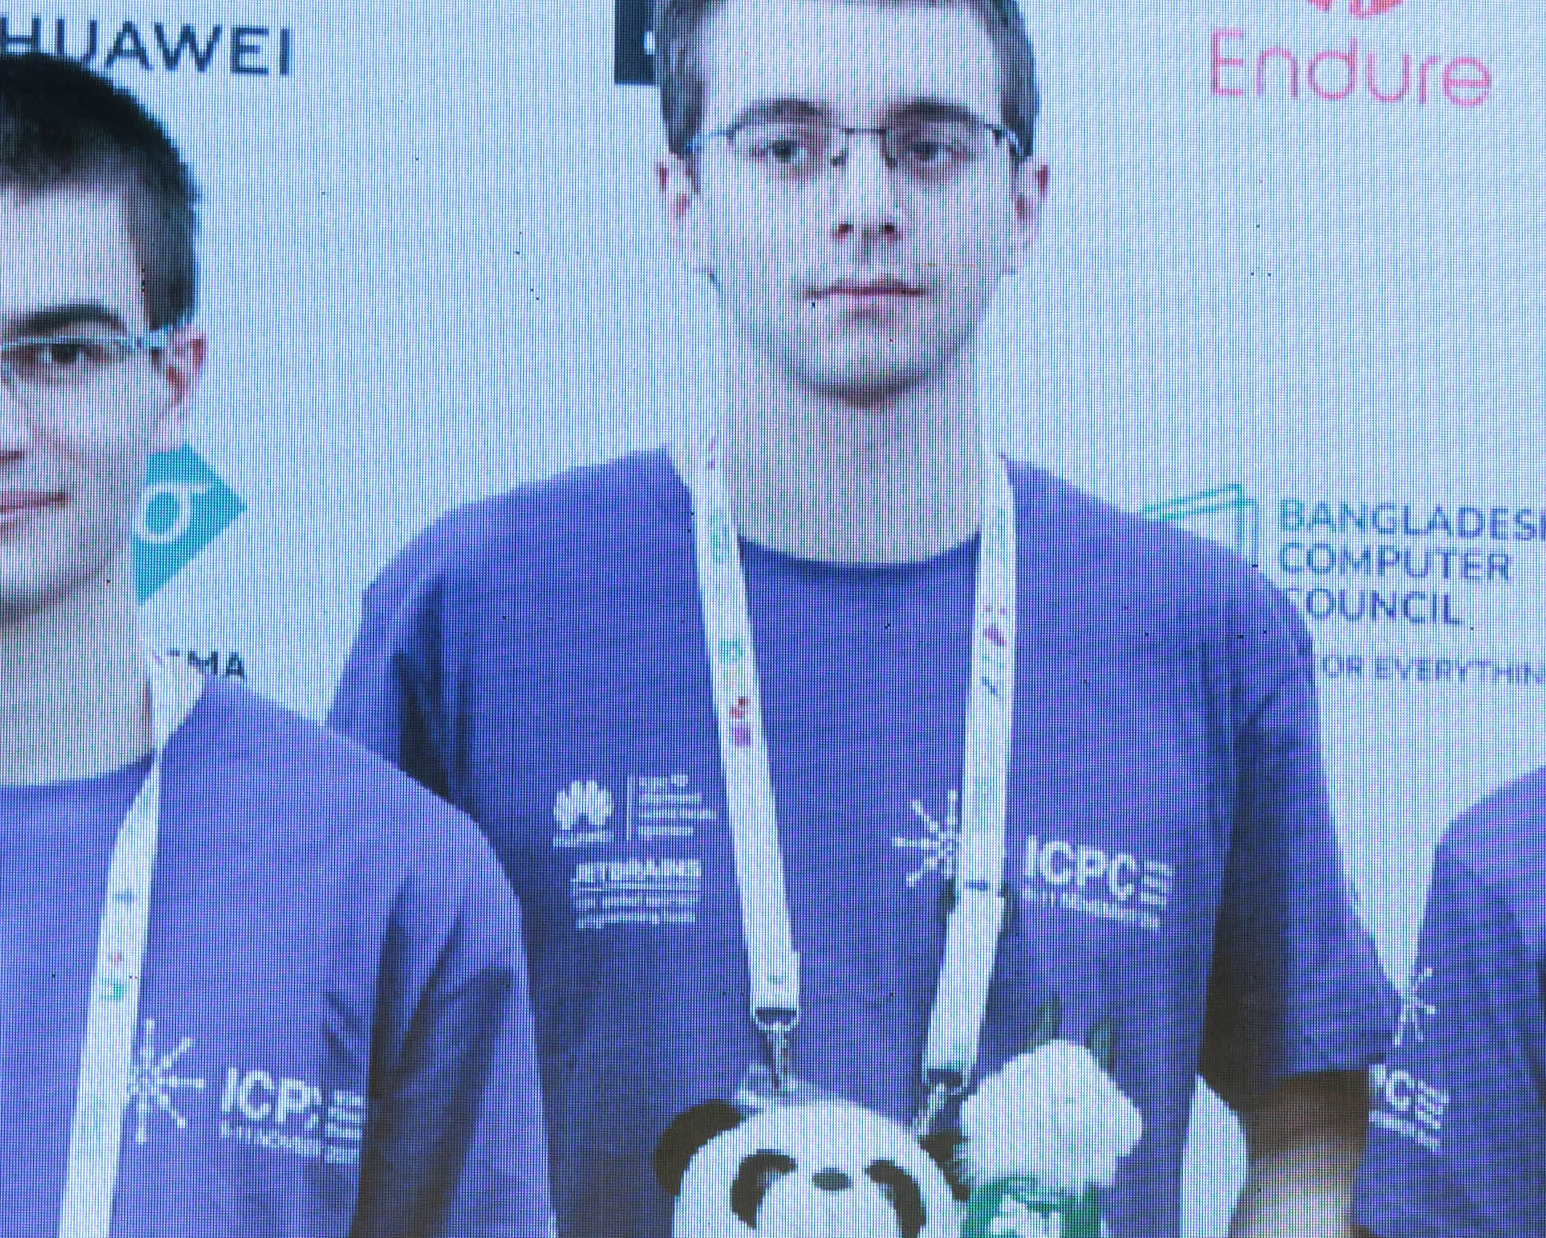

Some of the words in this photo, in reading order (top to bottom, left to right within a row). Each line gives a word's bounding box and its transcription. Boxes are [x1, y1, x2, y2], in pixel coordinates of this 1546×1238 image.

[1210, 28, 1493, 107] Endure
[1279, 542, 1512, 583] COMPUTER
[1323, 654, 1362, 681] OR
[1024, 834, 1138, 902] ICPC
